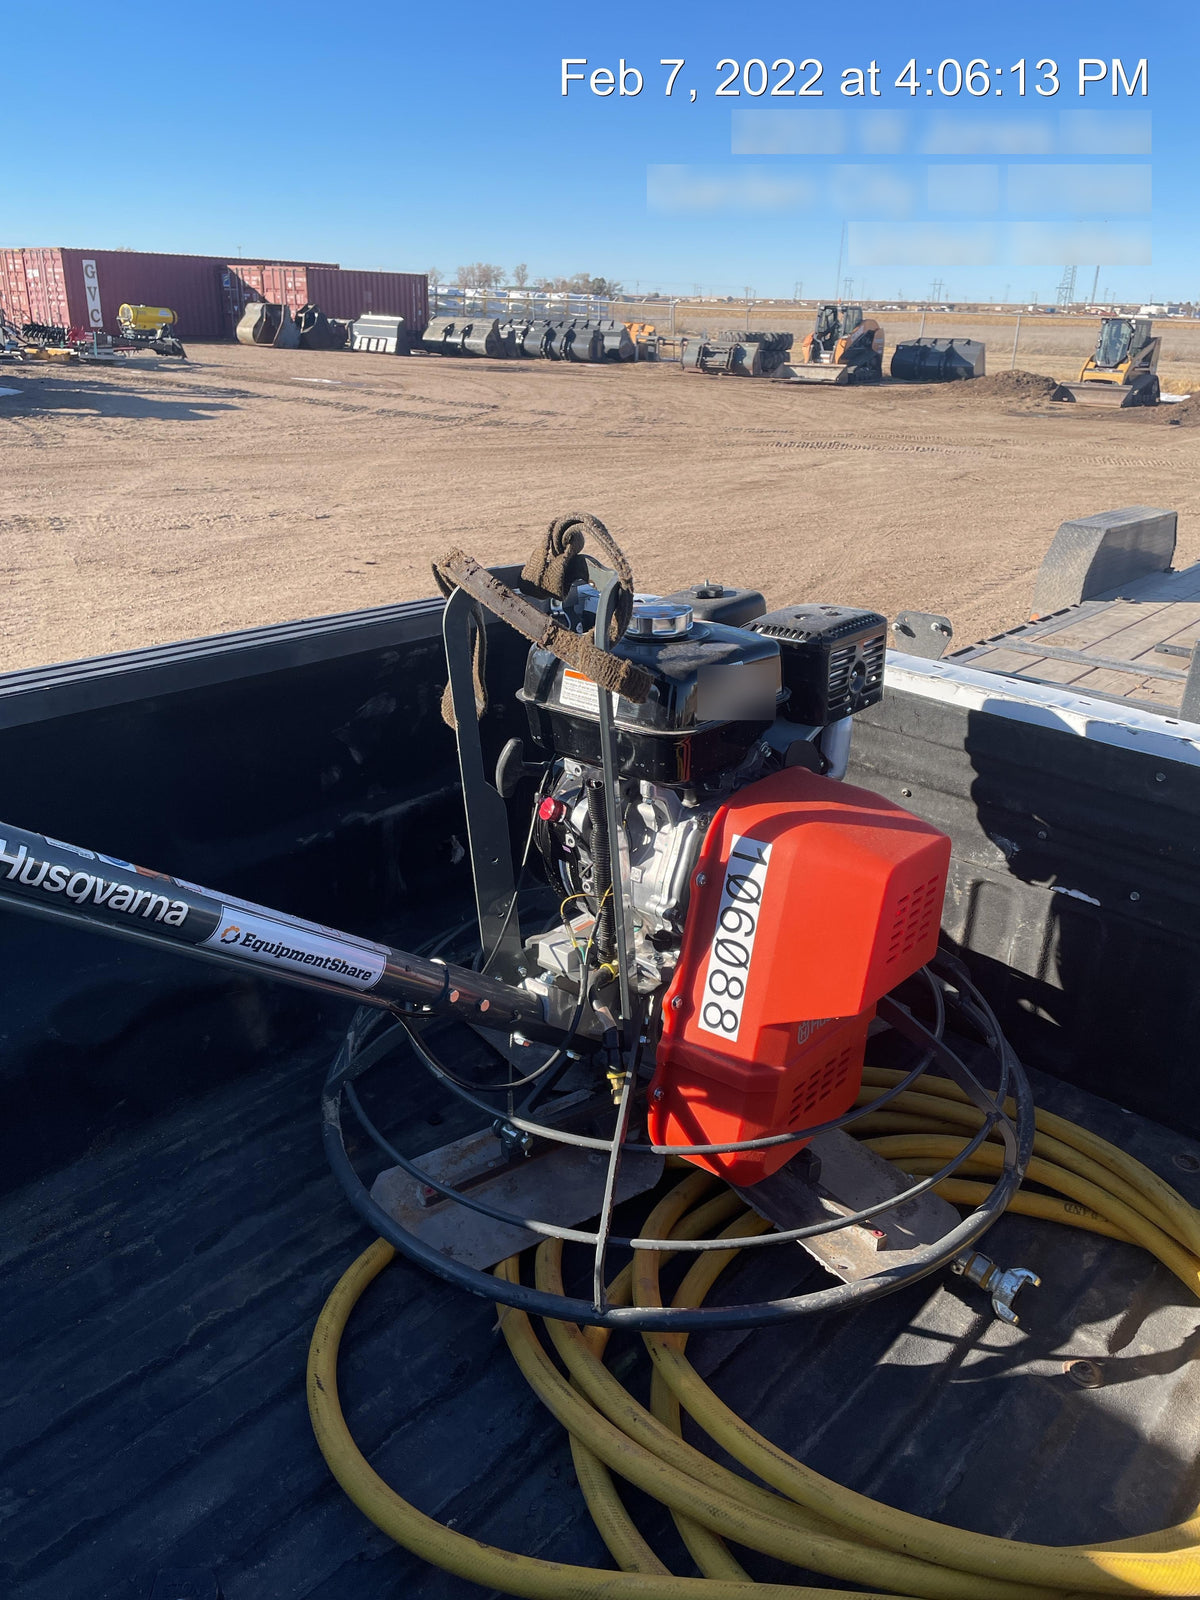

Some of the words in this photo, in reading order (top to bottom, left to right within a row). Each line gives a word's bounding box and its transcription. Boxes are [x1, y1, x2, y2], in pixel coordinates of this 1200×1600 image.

[0, 839, 189, 927] Husqvarna
[240, 932, 373, 981] EquipmentShare
[702, 847, 768, 1034] 106088
